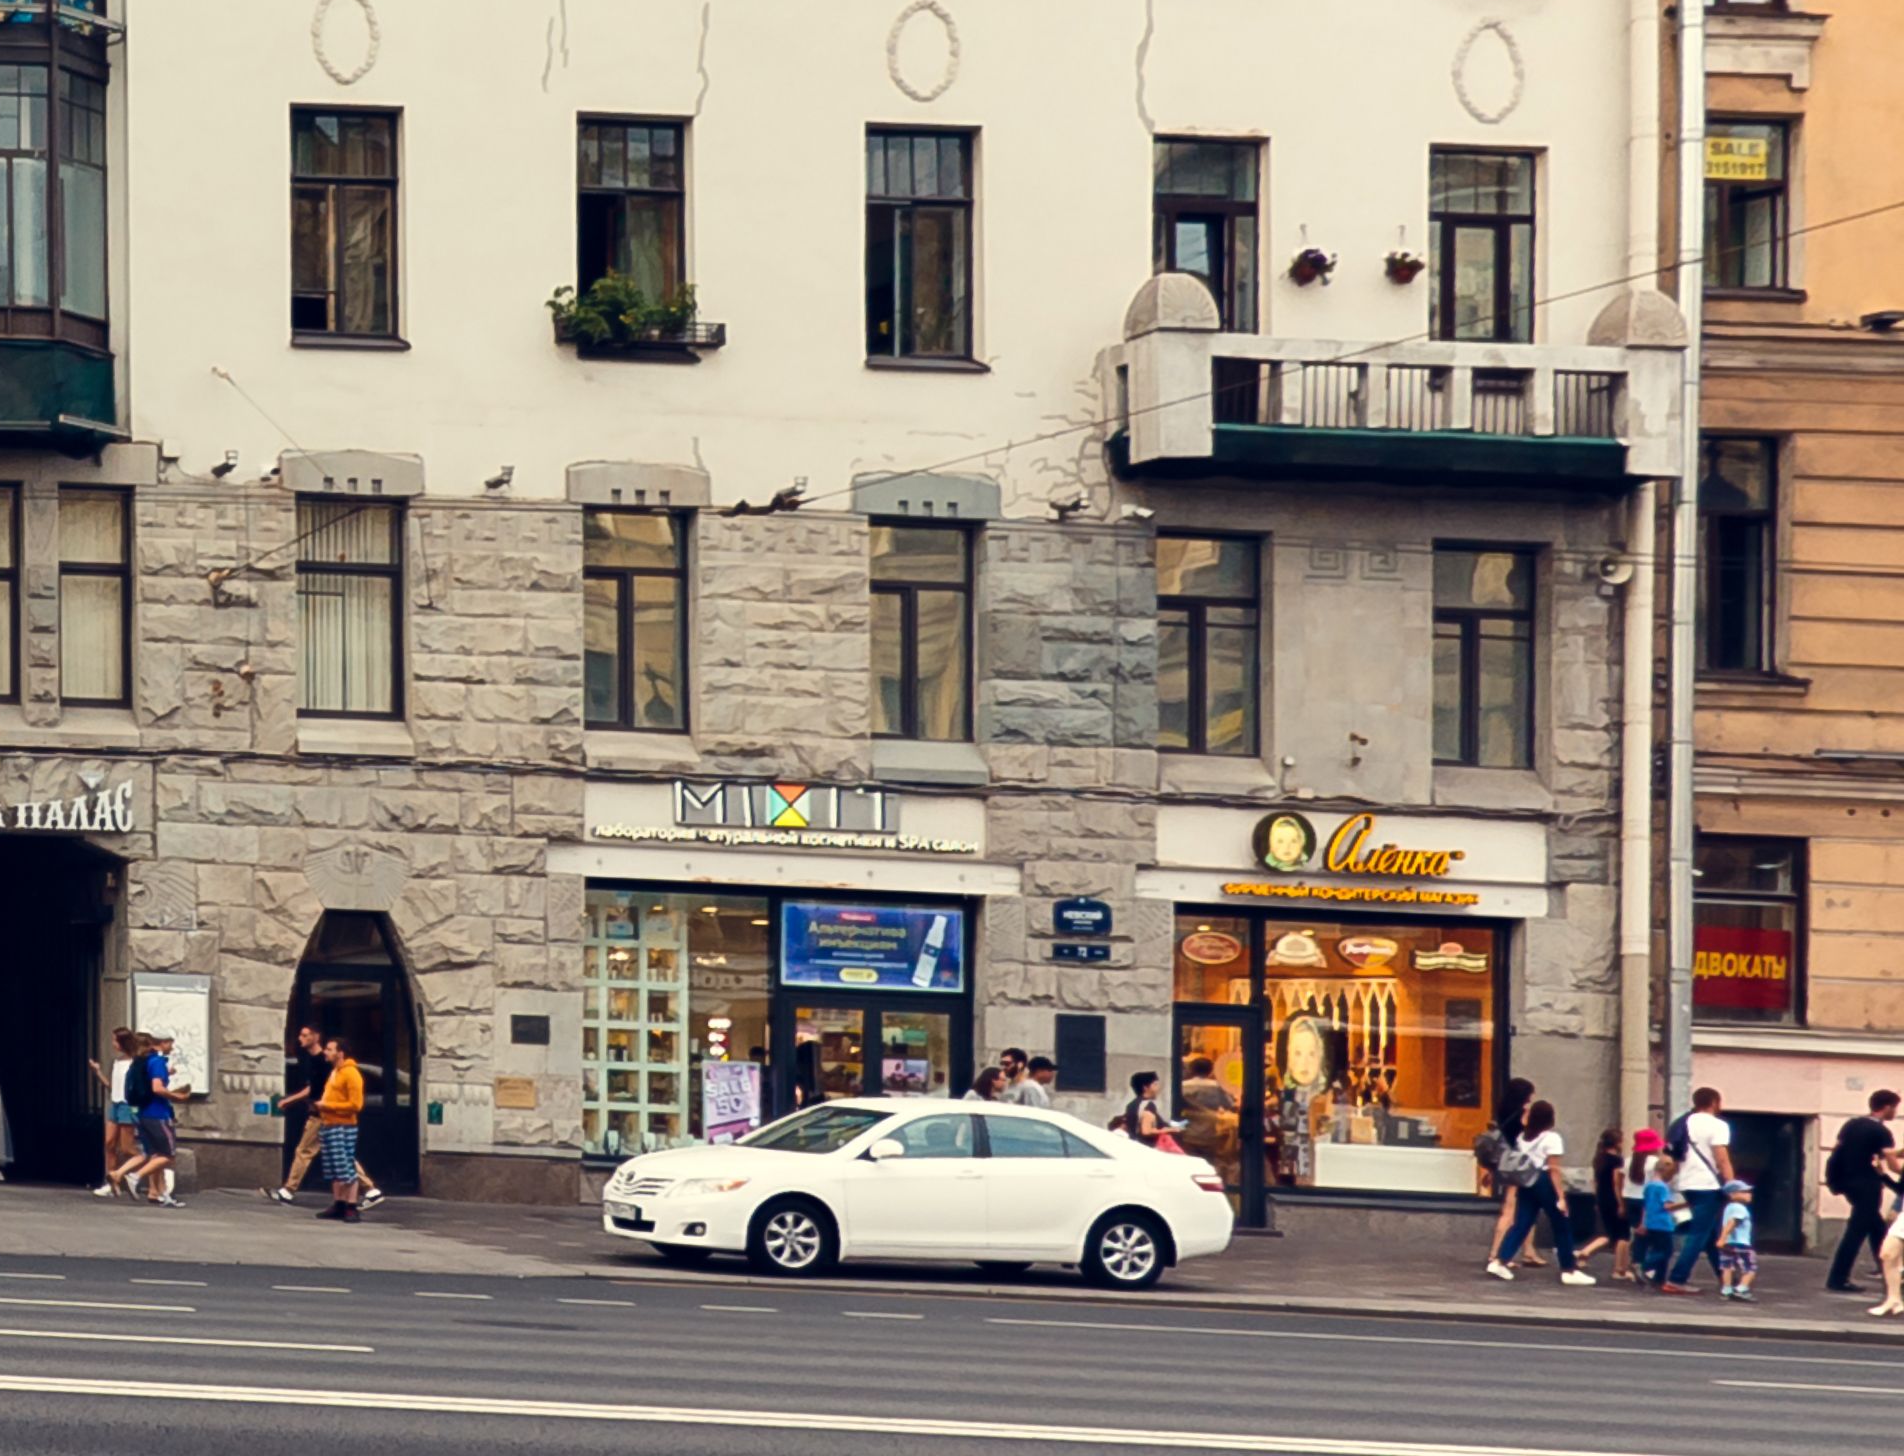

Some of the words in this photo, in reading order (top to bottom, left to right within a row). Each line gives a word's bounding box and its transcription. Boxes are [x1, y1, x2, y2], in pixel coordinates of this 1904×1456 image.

[1709, 141, 1761, 158] SALE
[15, 778, 135, 833] ПАЛАС
[594, 822, 697, 842] лаборатория
[899, 834, 931, 850] SPA
[932, 838, 979, 853] салон
[1325, 812, 1466, 877] Алёнка
[1692, 950, 1787, 980] ДВОКАТЫ
